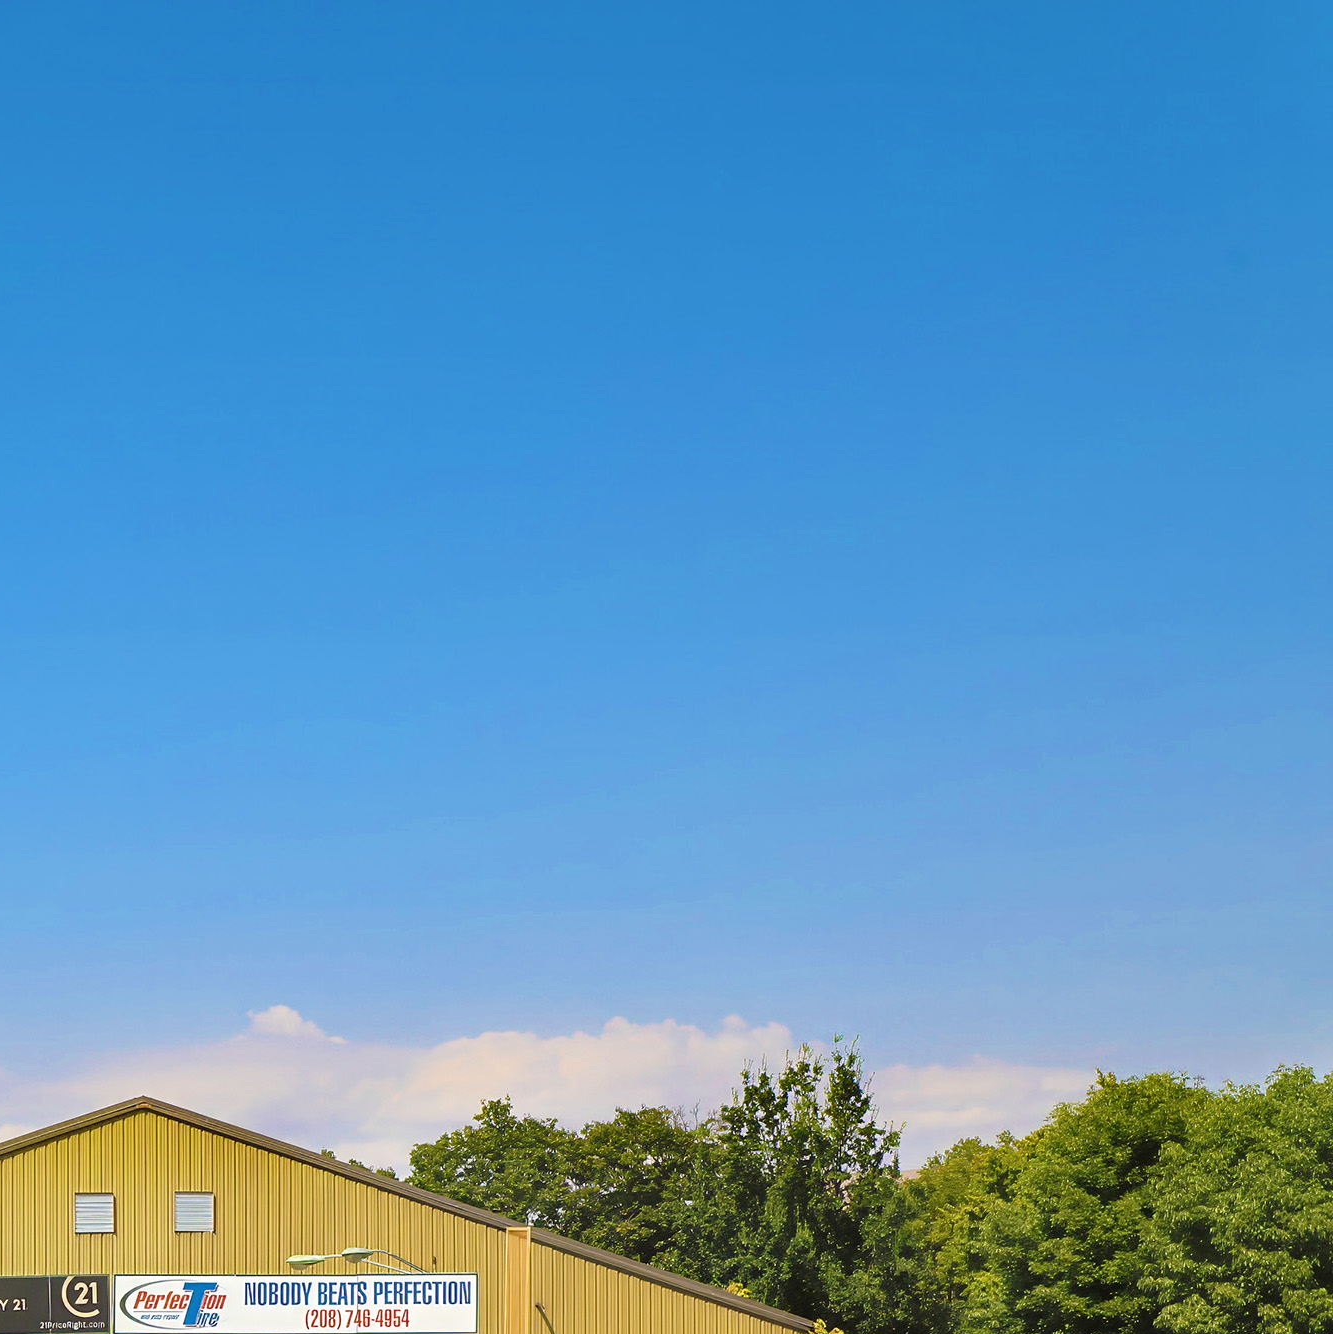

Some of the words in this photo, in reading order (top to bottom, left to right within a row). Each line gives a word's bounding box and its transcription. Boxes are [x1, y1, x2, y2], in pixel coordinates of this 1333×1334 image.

[244, 1281, 313, 1306] NOBODY
[317, 1281, 367, 1306] BEATS
[373, 1280, 472, 1305] PERFECTION
[12, 1298, 27, 1312] 21
[305, 1309, 342, 1329] (208)
[345, 1309, 410, 1328] 746-4954
